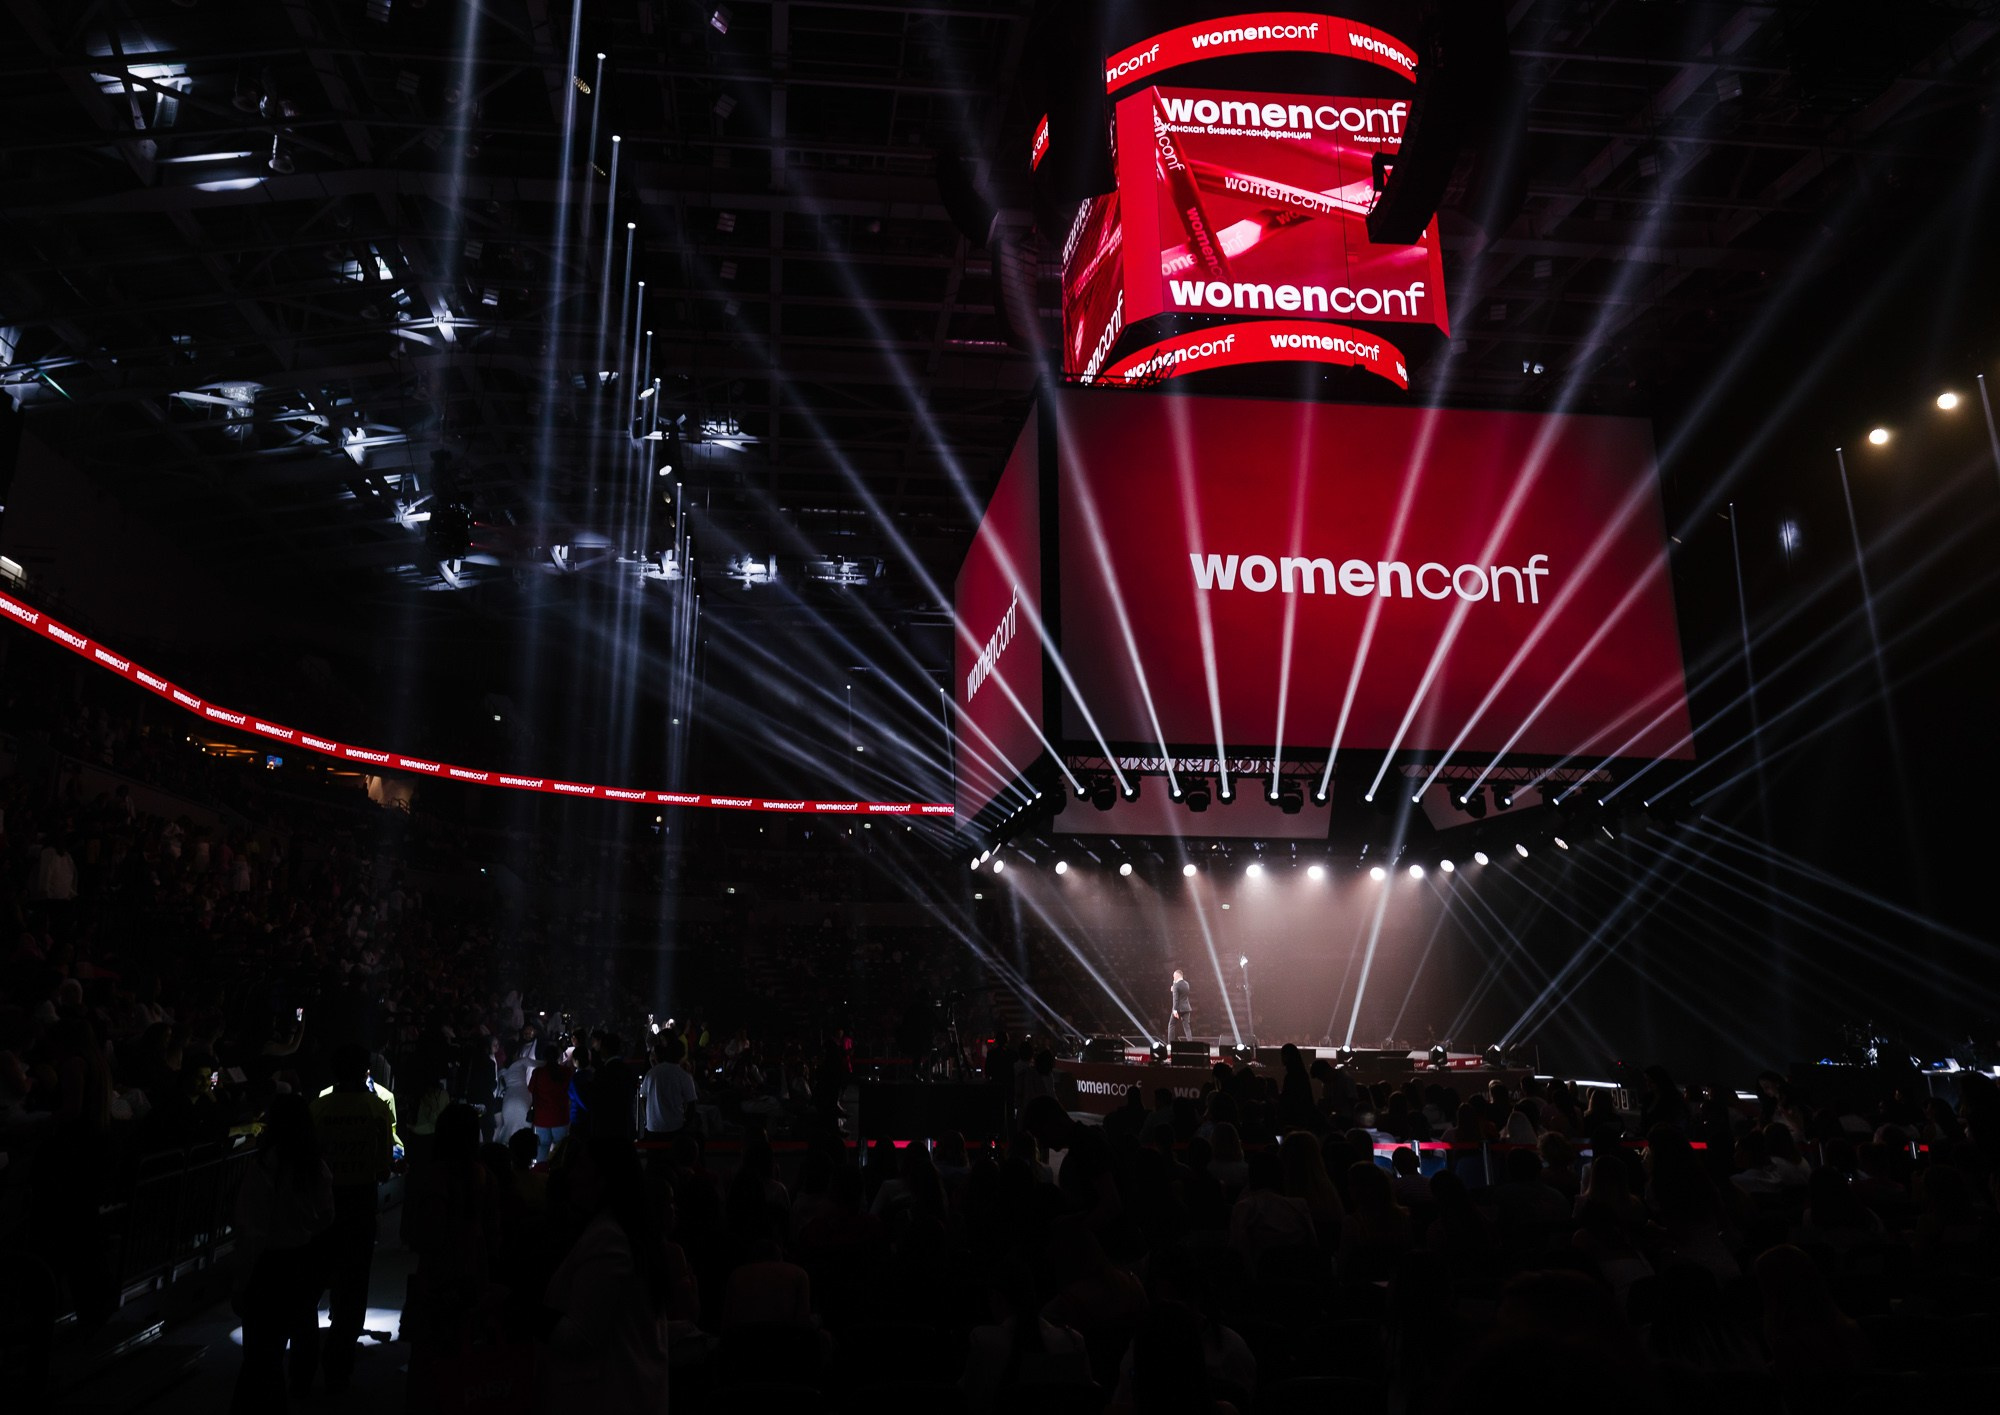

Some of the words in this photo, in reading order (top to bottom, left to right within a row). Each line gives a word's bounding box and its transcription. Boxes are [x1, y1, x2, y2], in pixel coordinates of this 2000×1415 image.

[1192, 23, 1319, 49] womenconf
[1160, 97, 1408, 134] womenconf
[1169, 278, 1425, 317] womenconf
[1269, 333, 1380, 362] womenconf
[1189, 552, 1550, 604] womenconf
[966, 583, 1018, 703] womenconf
[48, 623, 88, 650] womenconf
[95, 648, 130, 673] womenconf
[206, 707, 246, 726] womenconf
[256, 722, 293, 739] womenconf
[302, 735, 337, 752] womenconf
[346, 748, 390, 763] womenconf
[400, 758, 441, 773] womenconf
[450, 768, 489, 781] womenconf
[500, 776, 544, 788] womenconf
[554, 783, 596, 794] womenconf
[606, 789, 647, 800] womenconf
[658, 794, 701, 804] womenconf
[711, 798, 753, 807] womenconf
[763, 801, 805, 810] womenconf
[815, 802, 859, 811] womenconf
[869, 803, 912, 812] womenconf
